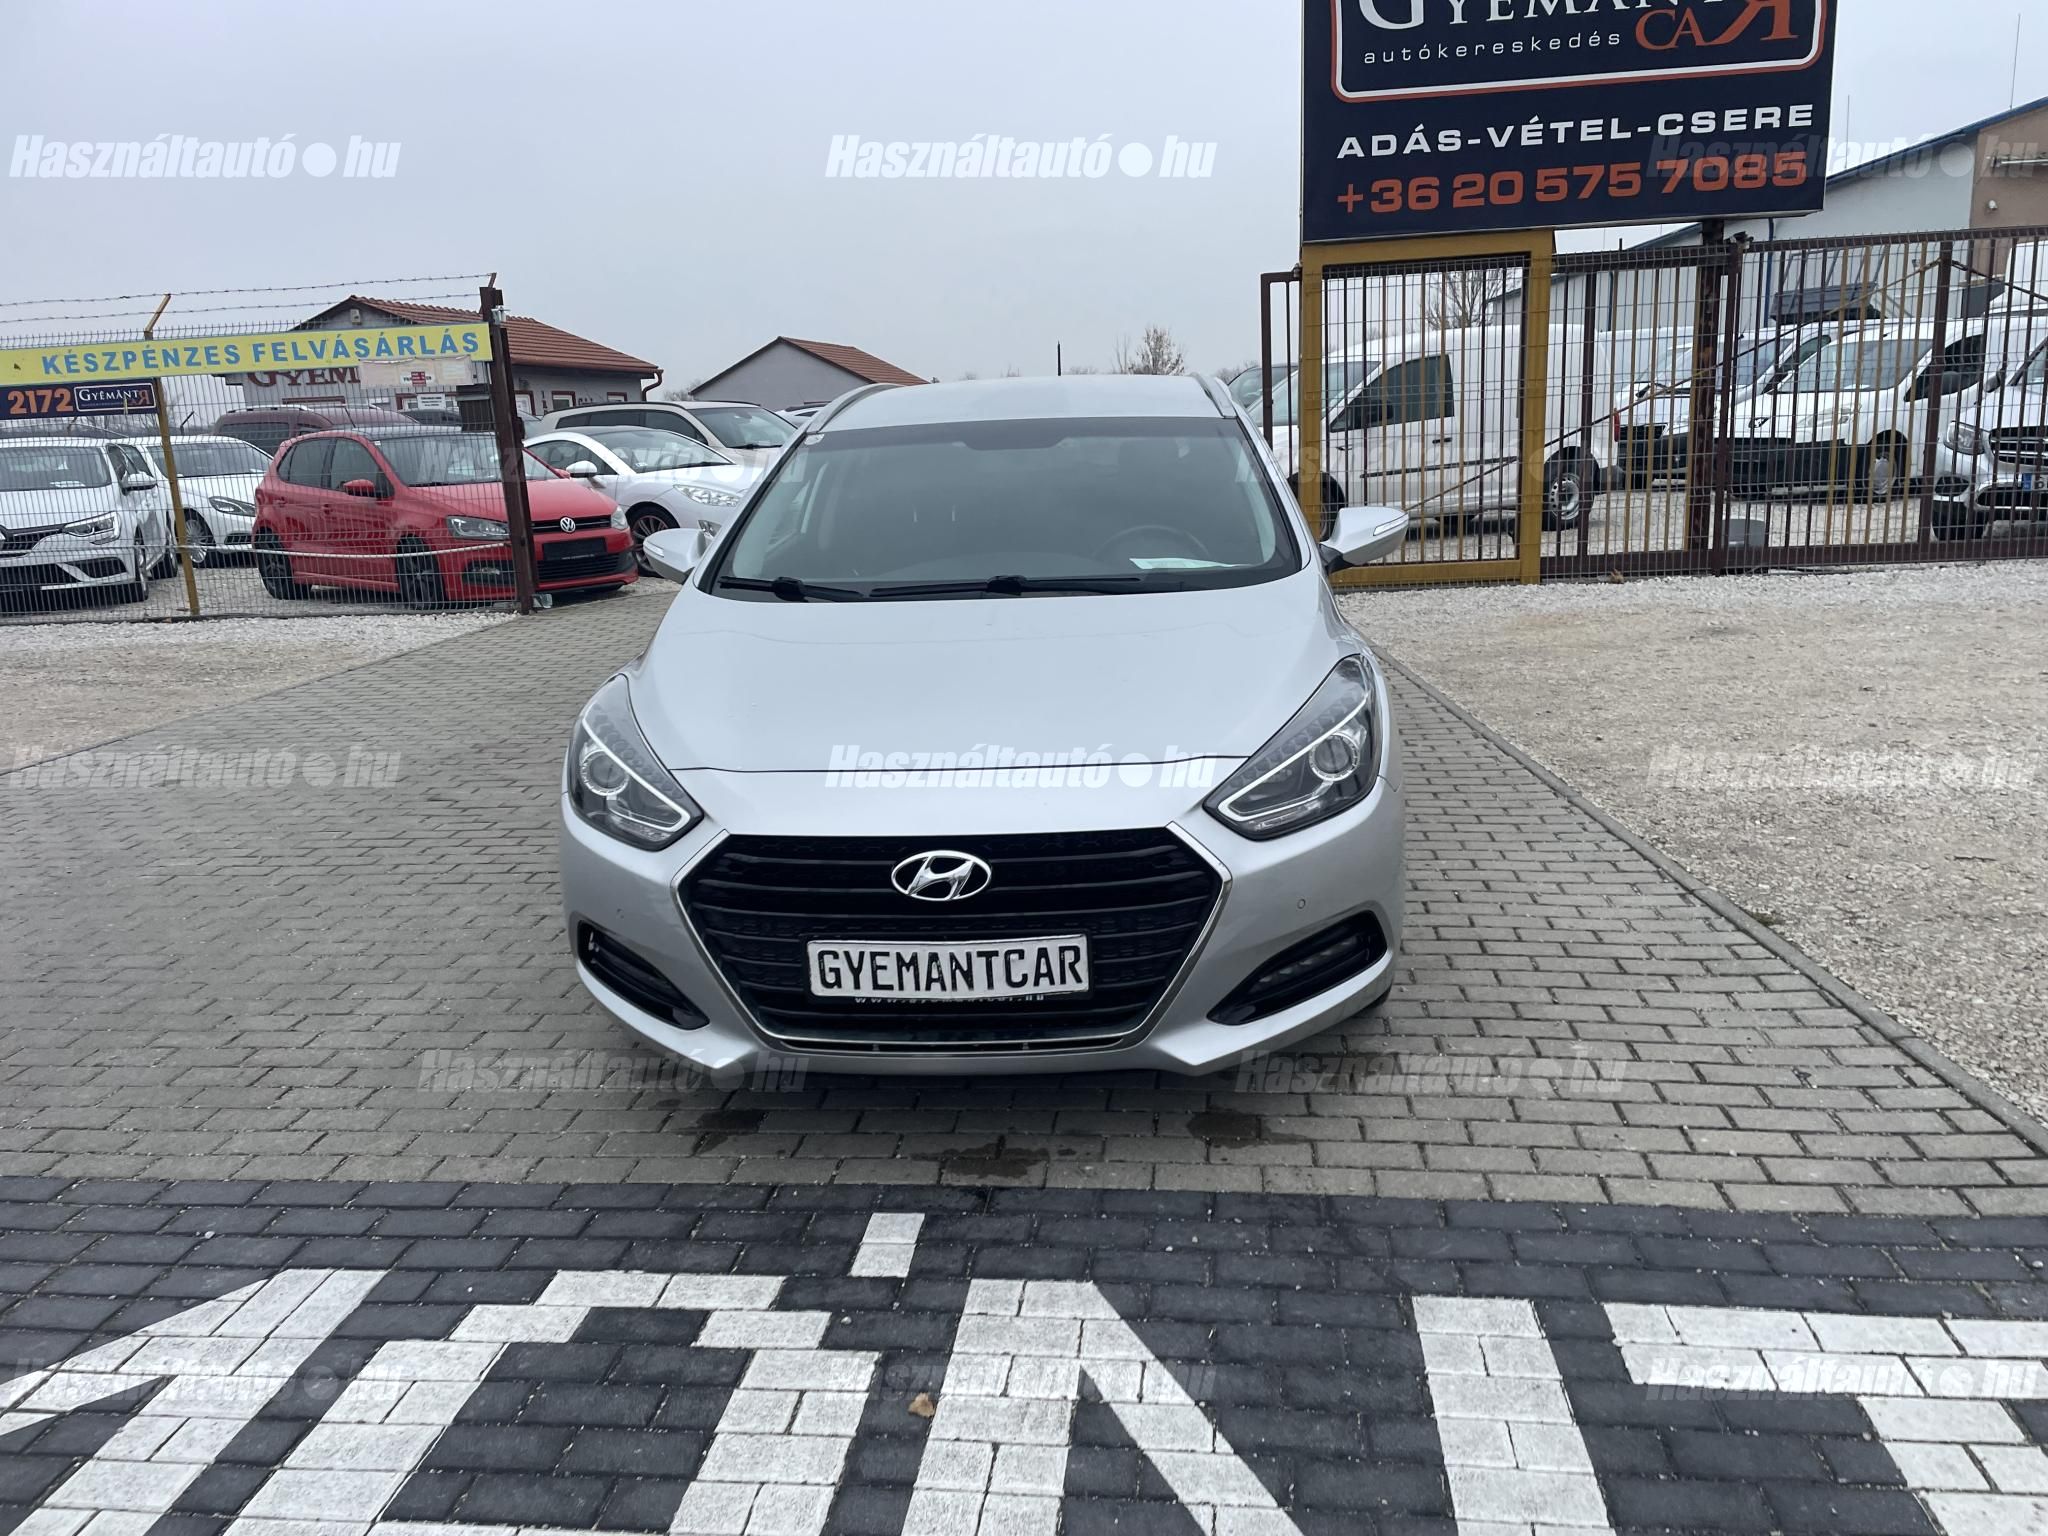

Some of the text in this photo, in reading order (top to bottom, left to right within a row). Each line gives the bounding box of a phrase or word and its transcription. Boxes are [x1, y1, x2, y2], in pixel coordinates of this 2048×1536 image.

[1364, 31, 1620, 64] autókereskedés
[1337, 104, 1813, 158] ADÁS-VÉTEL-CSERE
[1338, 151, 1807, 213] +36 20 575 7085
[42, 327, 480, 375] KÉSZPÉNZES FELVÁSÁRLÁS
[8, 388, 74, 415] 2172
[817, 945, 1083, 993] GYEMANTCAR
